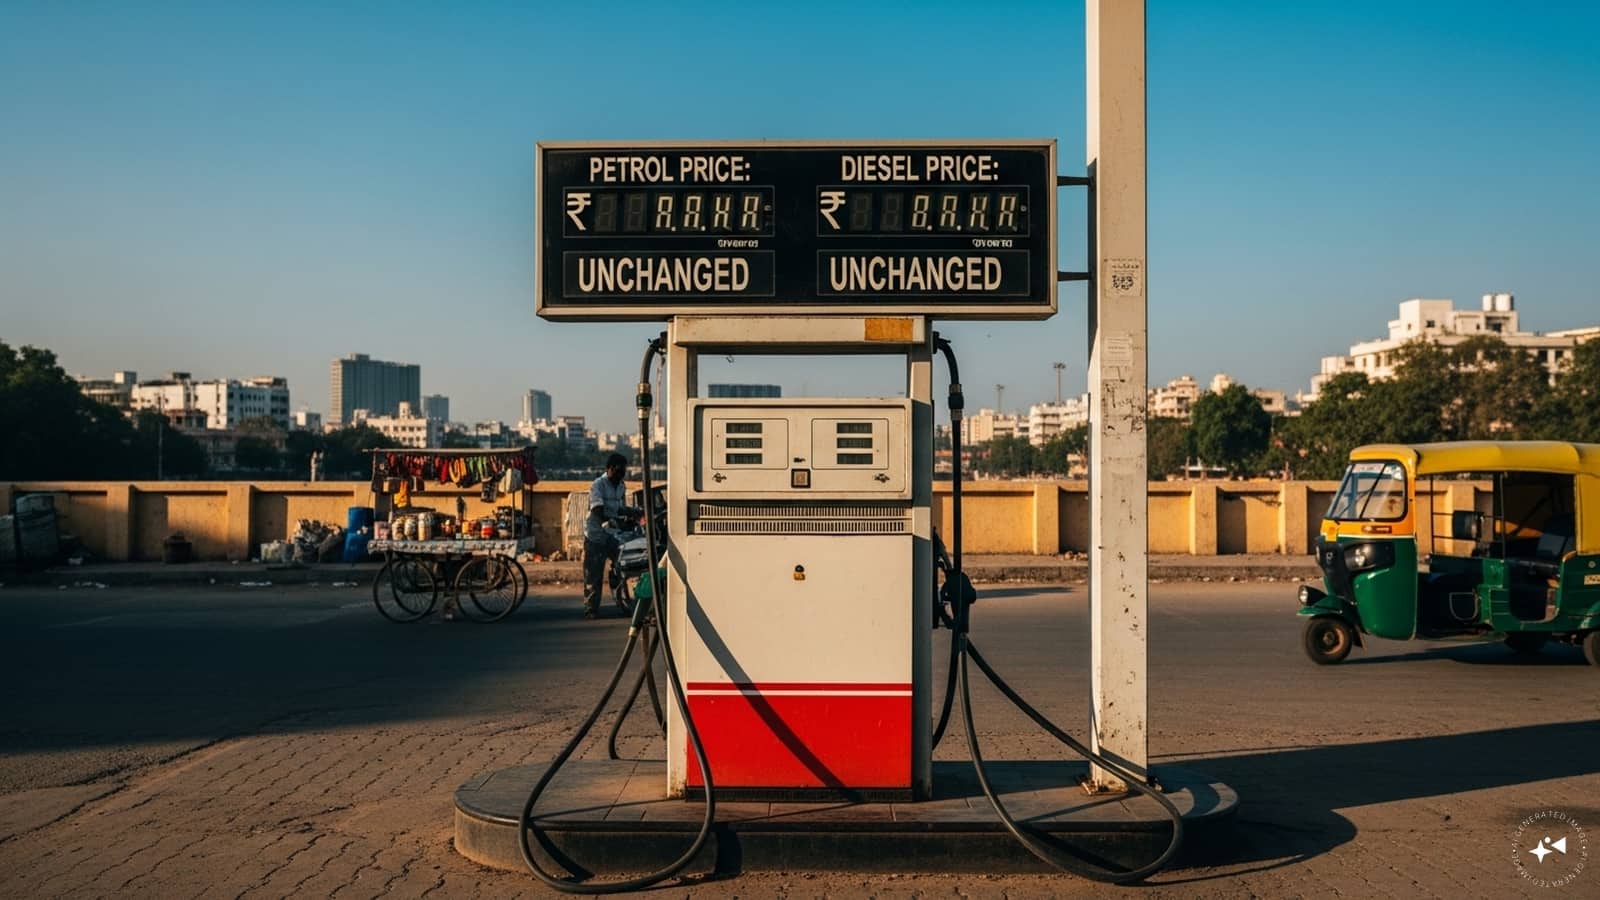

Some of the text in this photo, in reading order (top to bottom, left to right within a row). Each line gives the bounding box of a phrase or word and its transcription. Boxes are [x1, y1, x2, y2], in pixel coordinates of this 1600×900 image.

[589, 156, 751, 183] PETROL PRICE:
[841, 155, 999, 181] DIESEL PRICE:
[578, 257, 750, 292] UNCHANGED
[830, 256, 1002, 291] UNCHANGED
